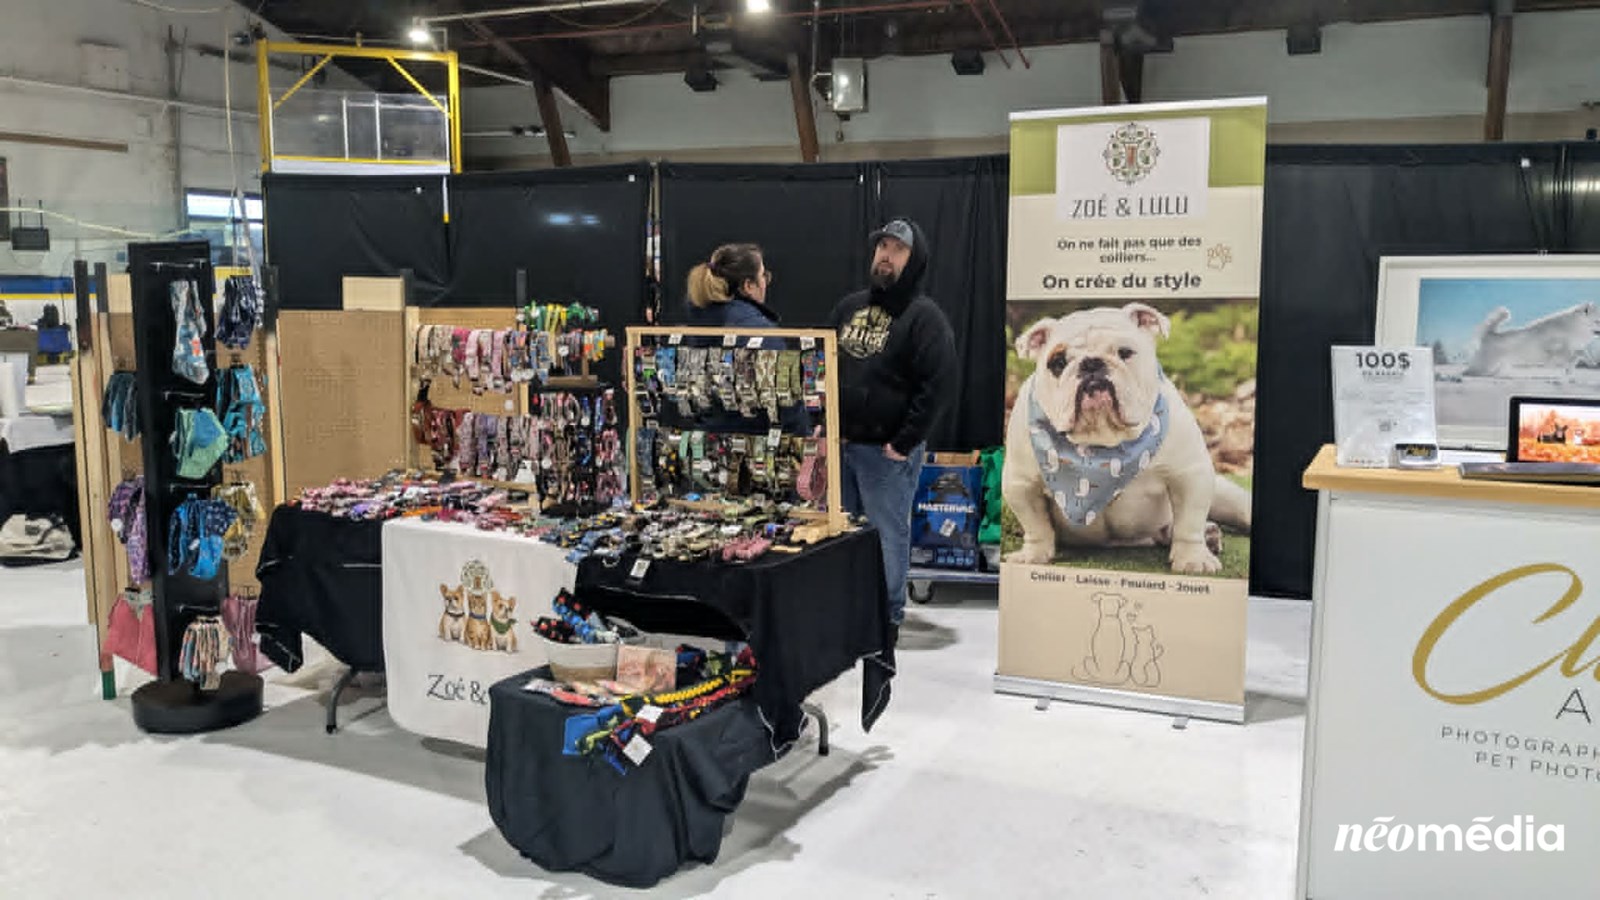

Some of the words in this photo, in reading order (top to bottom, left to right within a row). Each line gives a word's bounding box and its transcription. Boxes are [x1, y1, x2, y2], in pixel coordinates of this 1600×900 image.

[1072, 194, 1107, 218] ZOÉ
[1116, 197, 1131, 217] &
[1139, 196, 1188, 215] LULU
[1057, 238, 1076, 250] On
[1079, 239, 1094, 250] ne
[1099, 236, 1119, 249] fait
[1124, 238, 1146, 251] pas
[1150, 237, 1175, 250] que
[1178, 235, 1202, 247] des
[1043, 274, 1070, 289] On
[1075, 273, 1117, 288] crée
[1122, 272, 1147, 288] du
[1153, 271, 1202, 291] style
[1356, 351, 1411, 369] 100$
[1076, 574, 1111, 586] Laisse
[1121, 578, 1166, 590] Foulard
[426, 674, 465, 701] Zoé
[1475, 751, 1517, 769] PET
